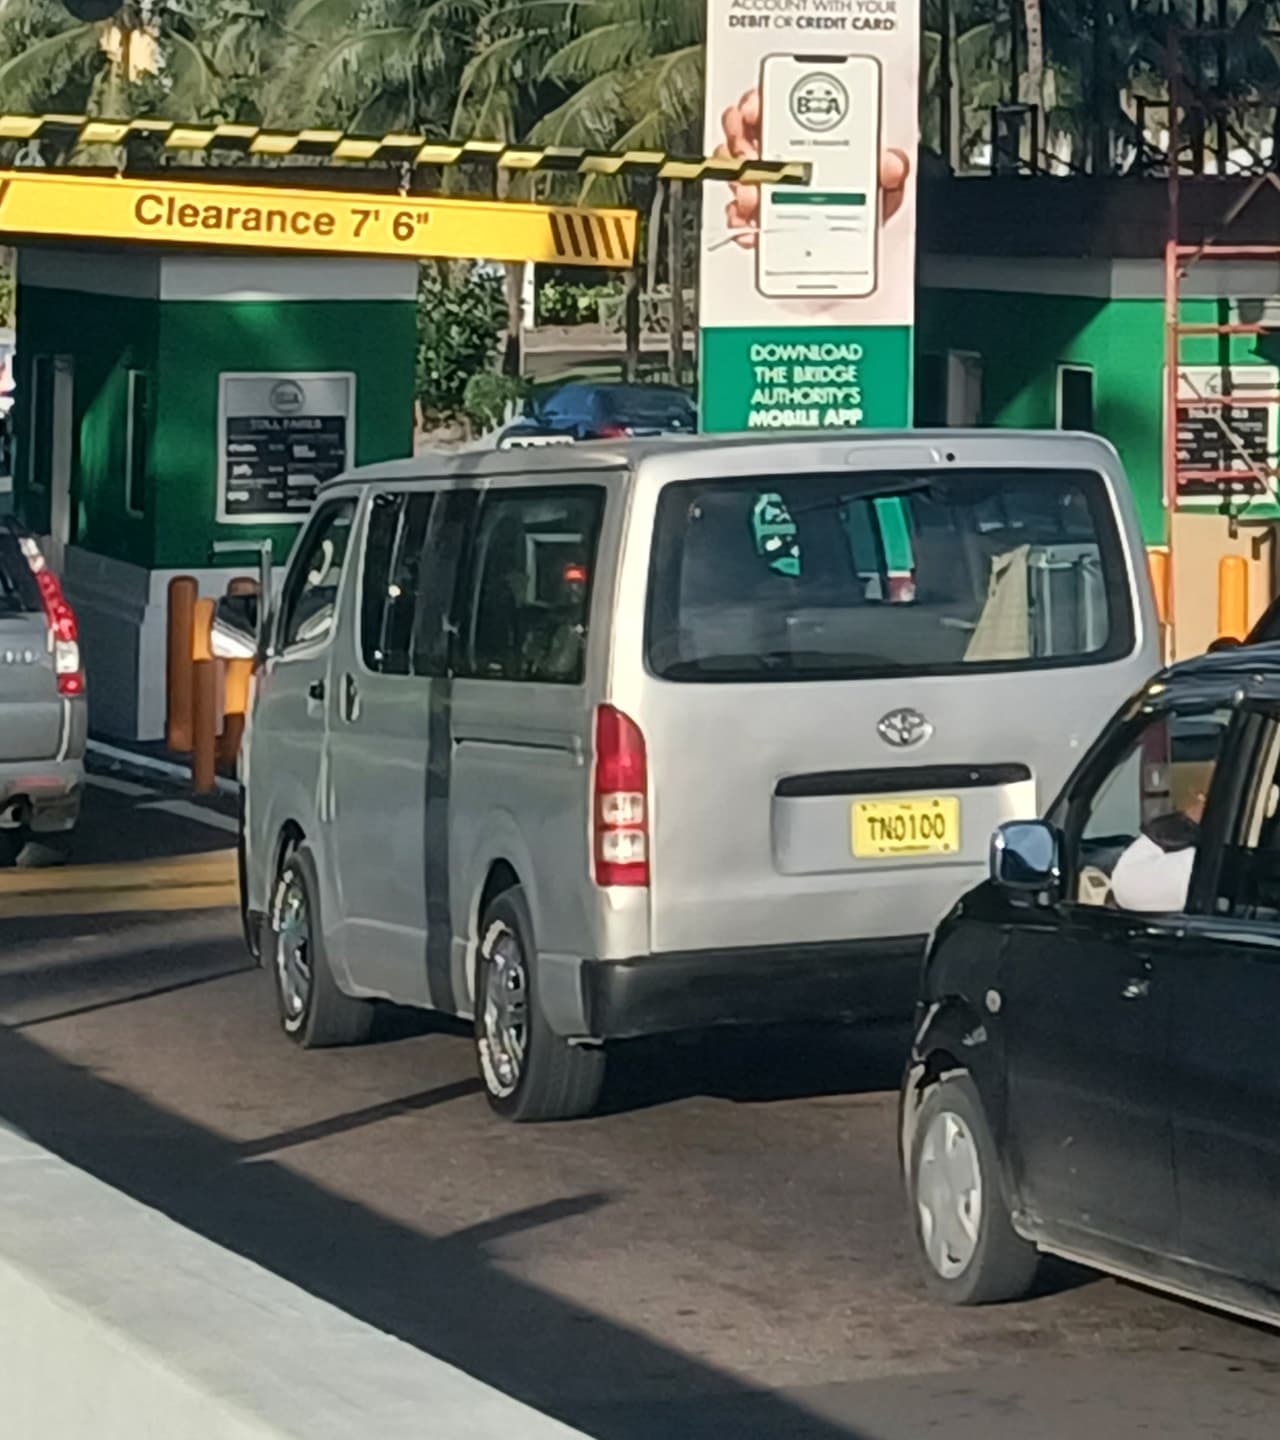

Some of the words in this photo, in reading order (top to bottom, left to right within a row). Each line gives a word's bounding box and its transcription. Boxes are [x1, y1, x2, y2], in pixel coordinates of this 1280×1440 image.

[812, 0, 851, 12] WITH
[856, 0, 896, 13] YOUR
[729, 15, 770, 28] DEBIT
[774, 16, 793, 28] OR
[796, 16, 846, 29] CREDIT
[135, 194, 335, 236] Clearance
[350, 209, 380, 237] 7'
[393, 211, 429, 242] 6"
[750, 344, 862, 361] DOWNLOAD
[754, 366, 788, 383] THE
[793, 365, 857, 383] BRIDGE
[751, 387, 860, 405] AUTHORITY'S
[748, 409, 819, 427] MOBILE
[824, 409, 862, 426] APP
